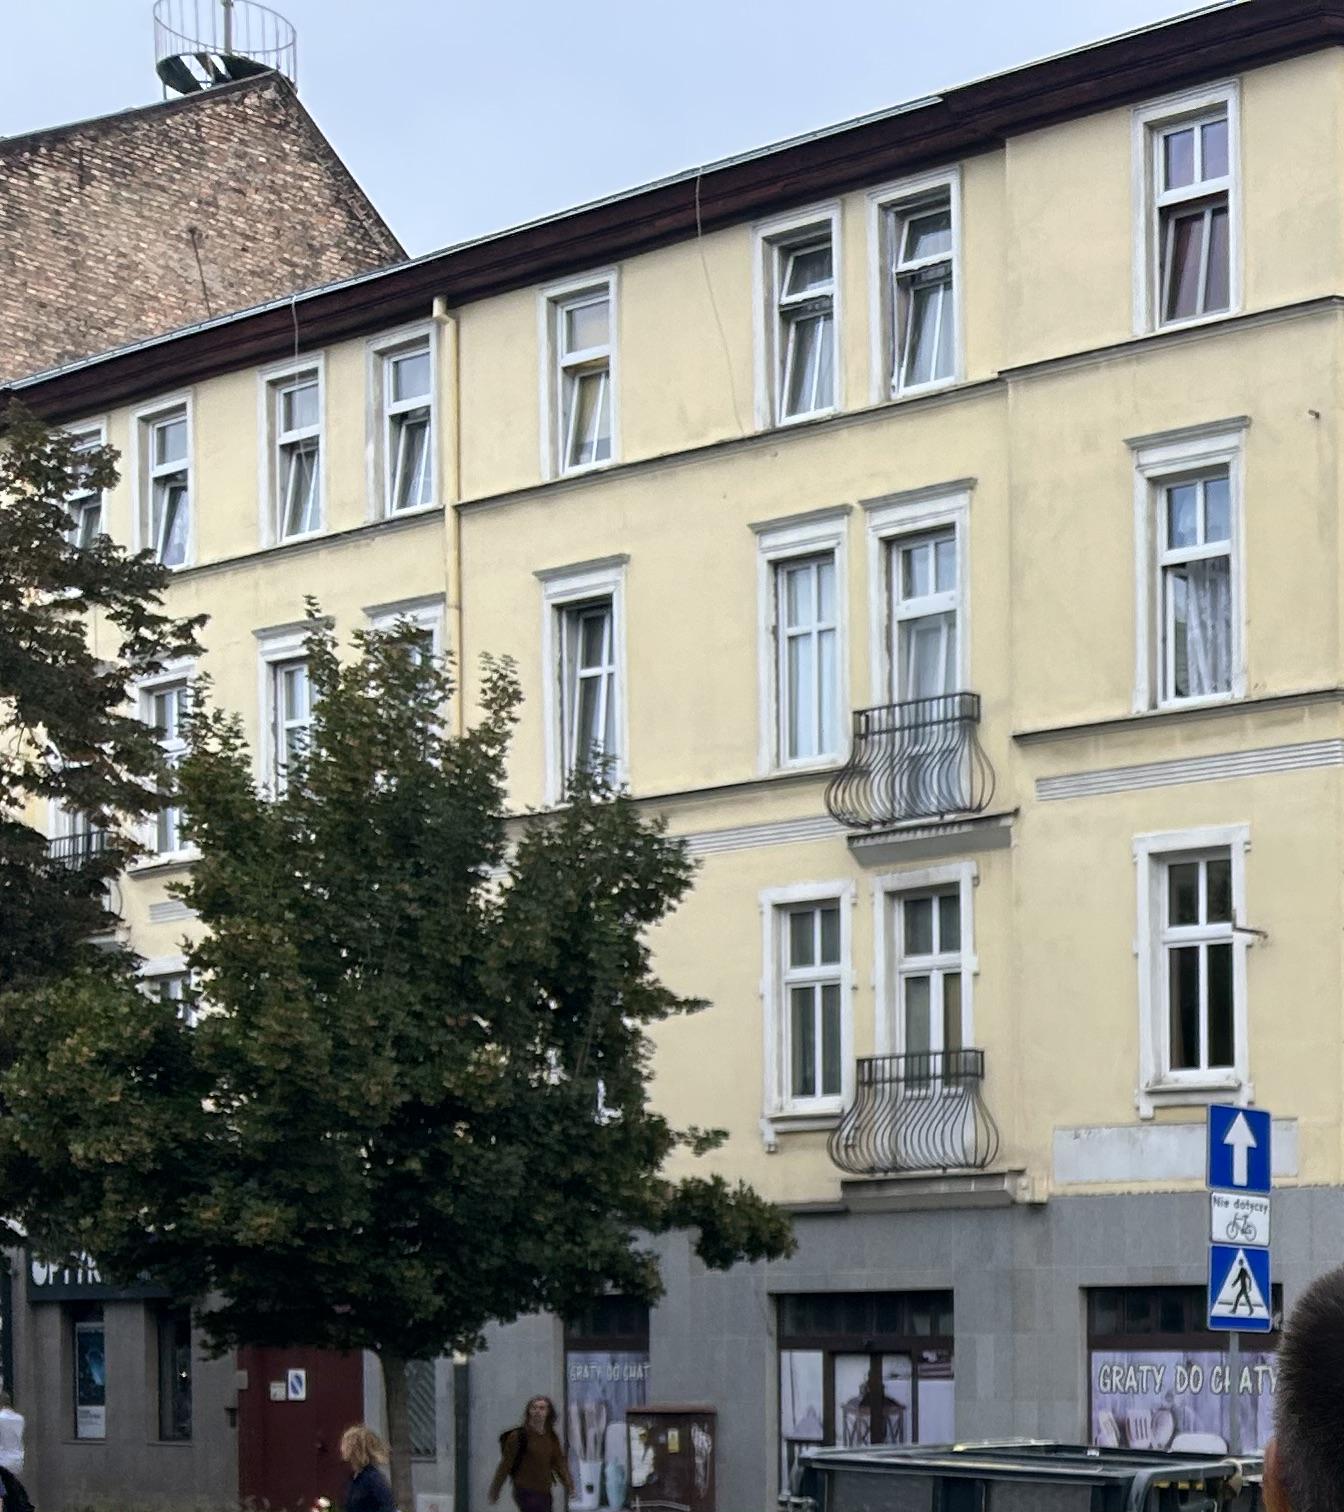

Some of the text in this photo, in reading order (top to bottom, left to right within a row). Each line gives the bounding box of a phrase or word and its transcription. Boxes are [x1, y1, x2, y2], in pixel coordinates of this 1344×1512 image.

[1213, 1196, 1268, 1215] Nie dotyczy
[623, 1362, 651, 1381] CHAT
[1099, 1364, 1166, 1394] GRATY
[1175, 1365, 1204, 1394] DO
